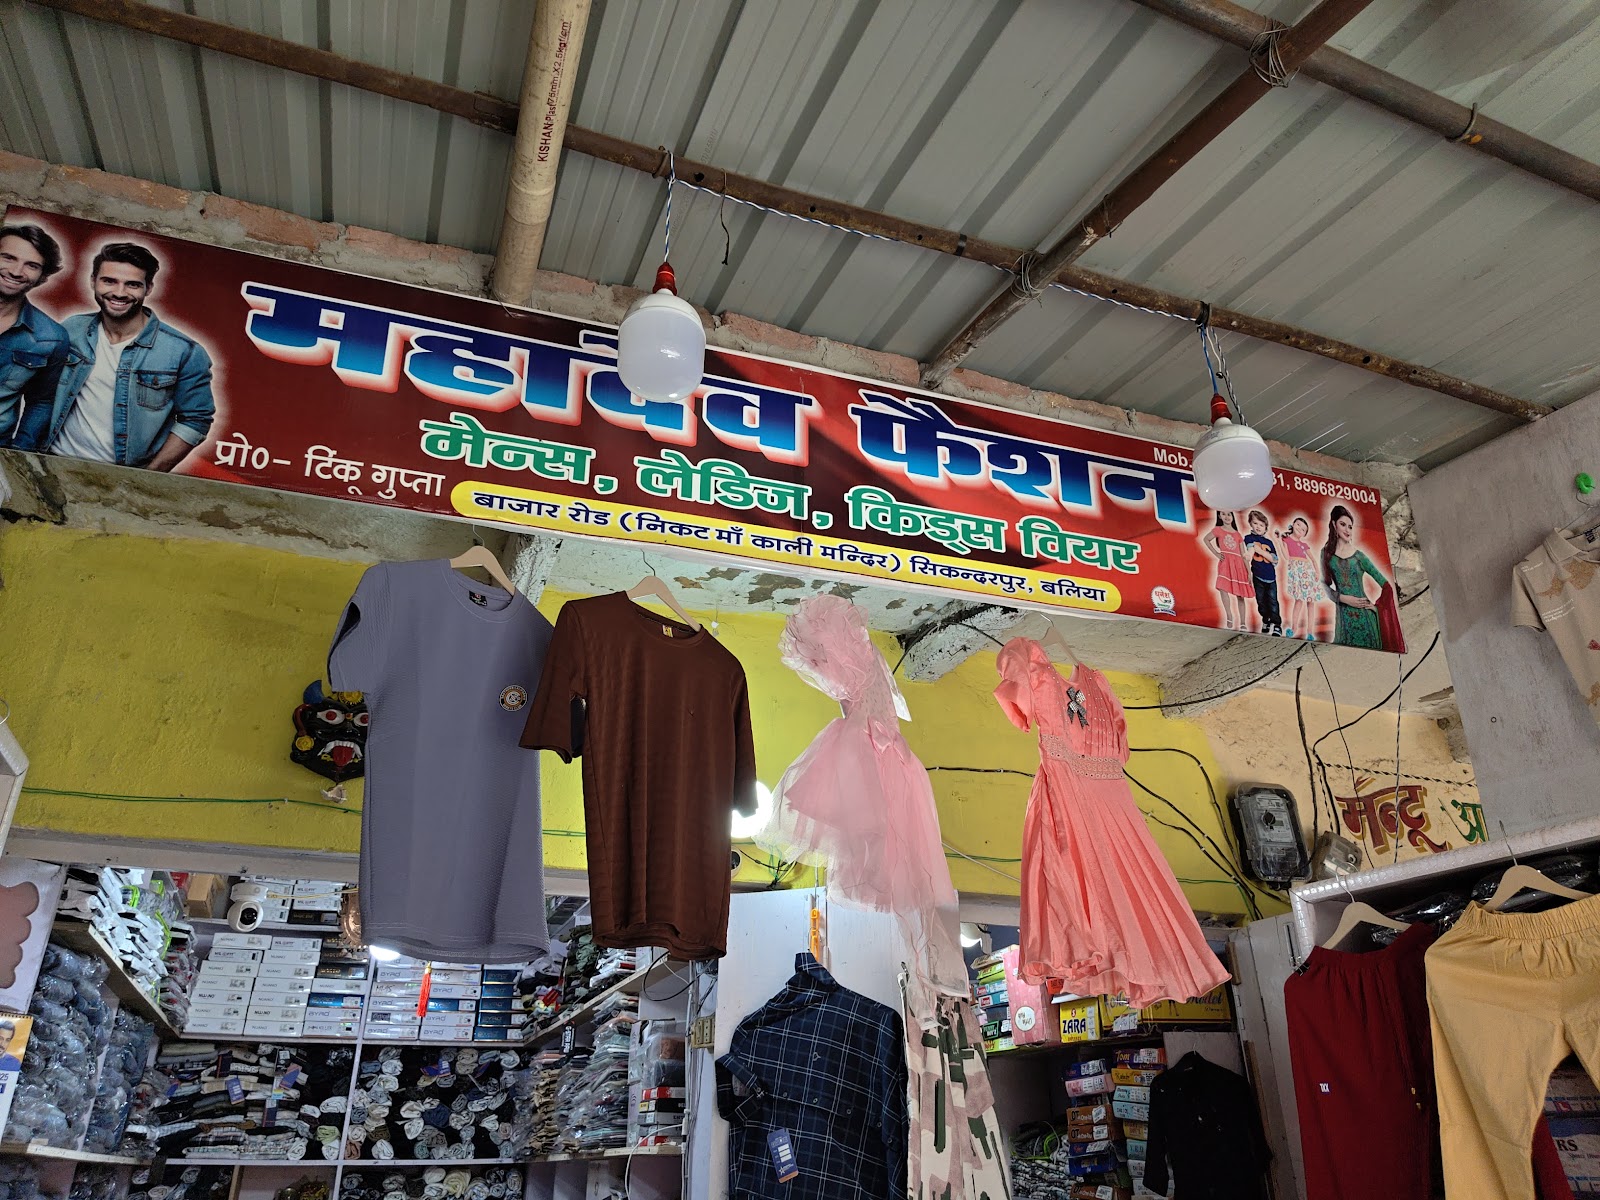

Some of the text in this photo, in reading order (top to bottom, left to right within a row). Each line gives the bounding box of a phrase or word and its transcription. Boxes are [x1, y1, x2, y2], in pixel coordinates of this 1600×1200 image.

[305, 445, 364, 495] टिंकू
[371, 463, 446, 499] गुप्ता
[849, 389, 1197, 530] फैशन
[1294, 476, 1378, 505] 8896829004
[473, 491, 559, 518] बाजार
[569, 502, 611, 526] रोड
[716, 525, 744, 545] माँ
[751, 535, 814, 557] काली
[1040, 579, 1107, 603] बलिया
[844, 486, 1008, 554] किड्स
[1019, 516, 1142, 574] वियर
[1062, 1018, 1087, 1035] ZARA
